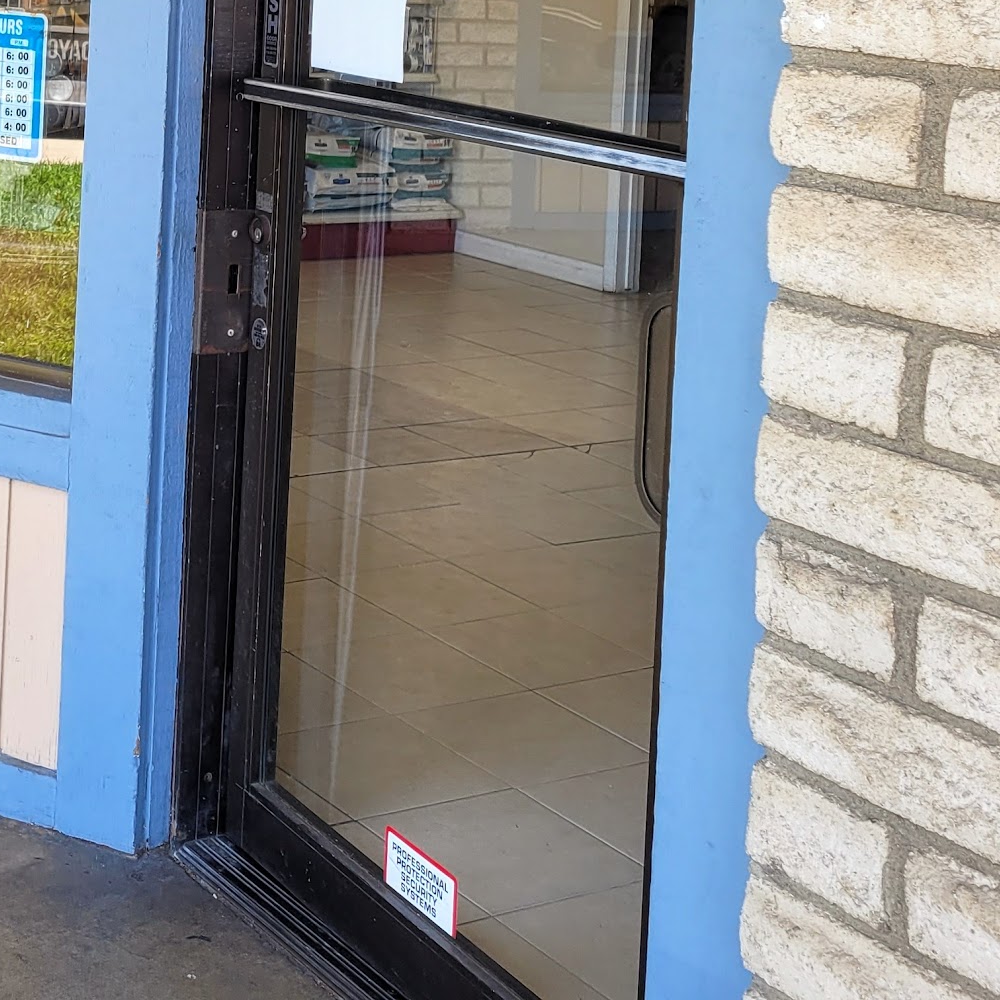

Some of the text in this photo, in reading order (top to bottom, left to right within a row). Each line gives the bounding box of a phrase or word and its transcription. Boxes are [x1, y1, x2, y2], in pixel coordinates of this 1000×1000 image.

[392, 842, 449, 894] PROFESSIONAL
[396, 857, 443, 901] PROTECTION
[401, 871, 437, 906] SECURITY
[401, 883, 437, 918] SYSTEMS
